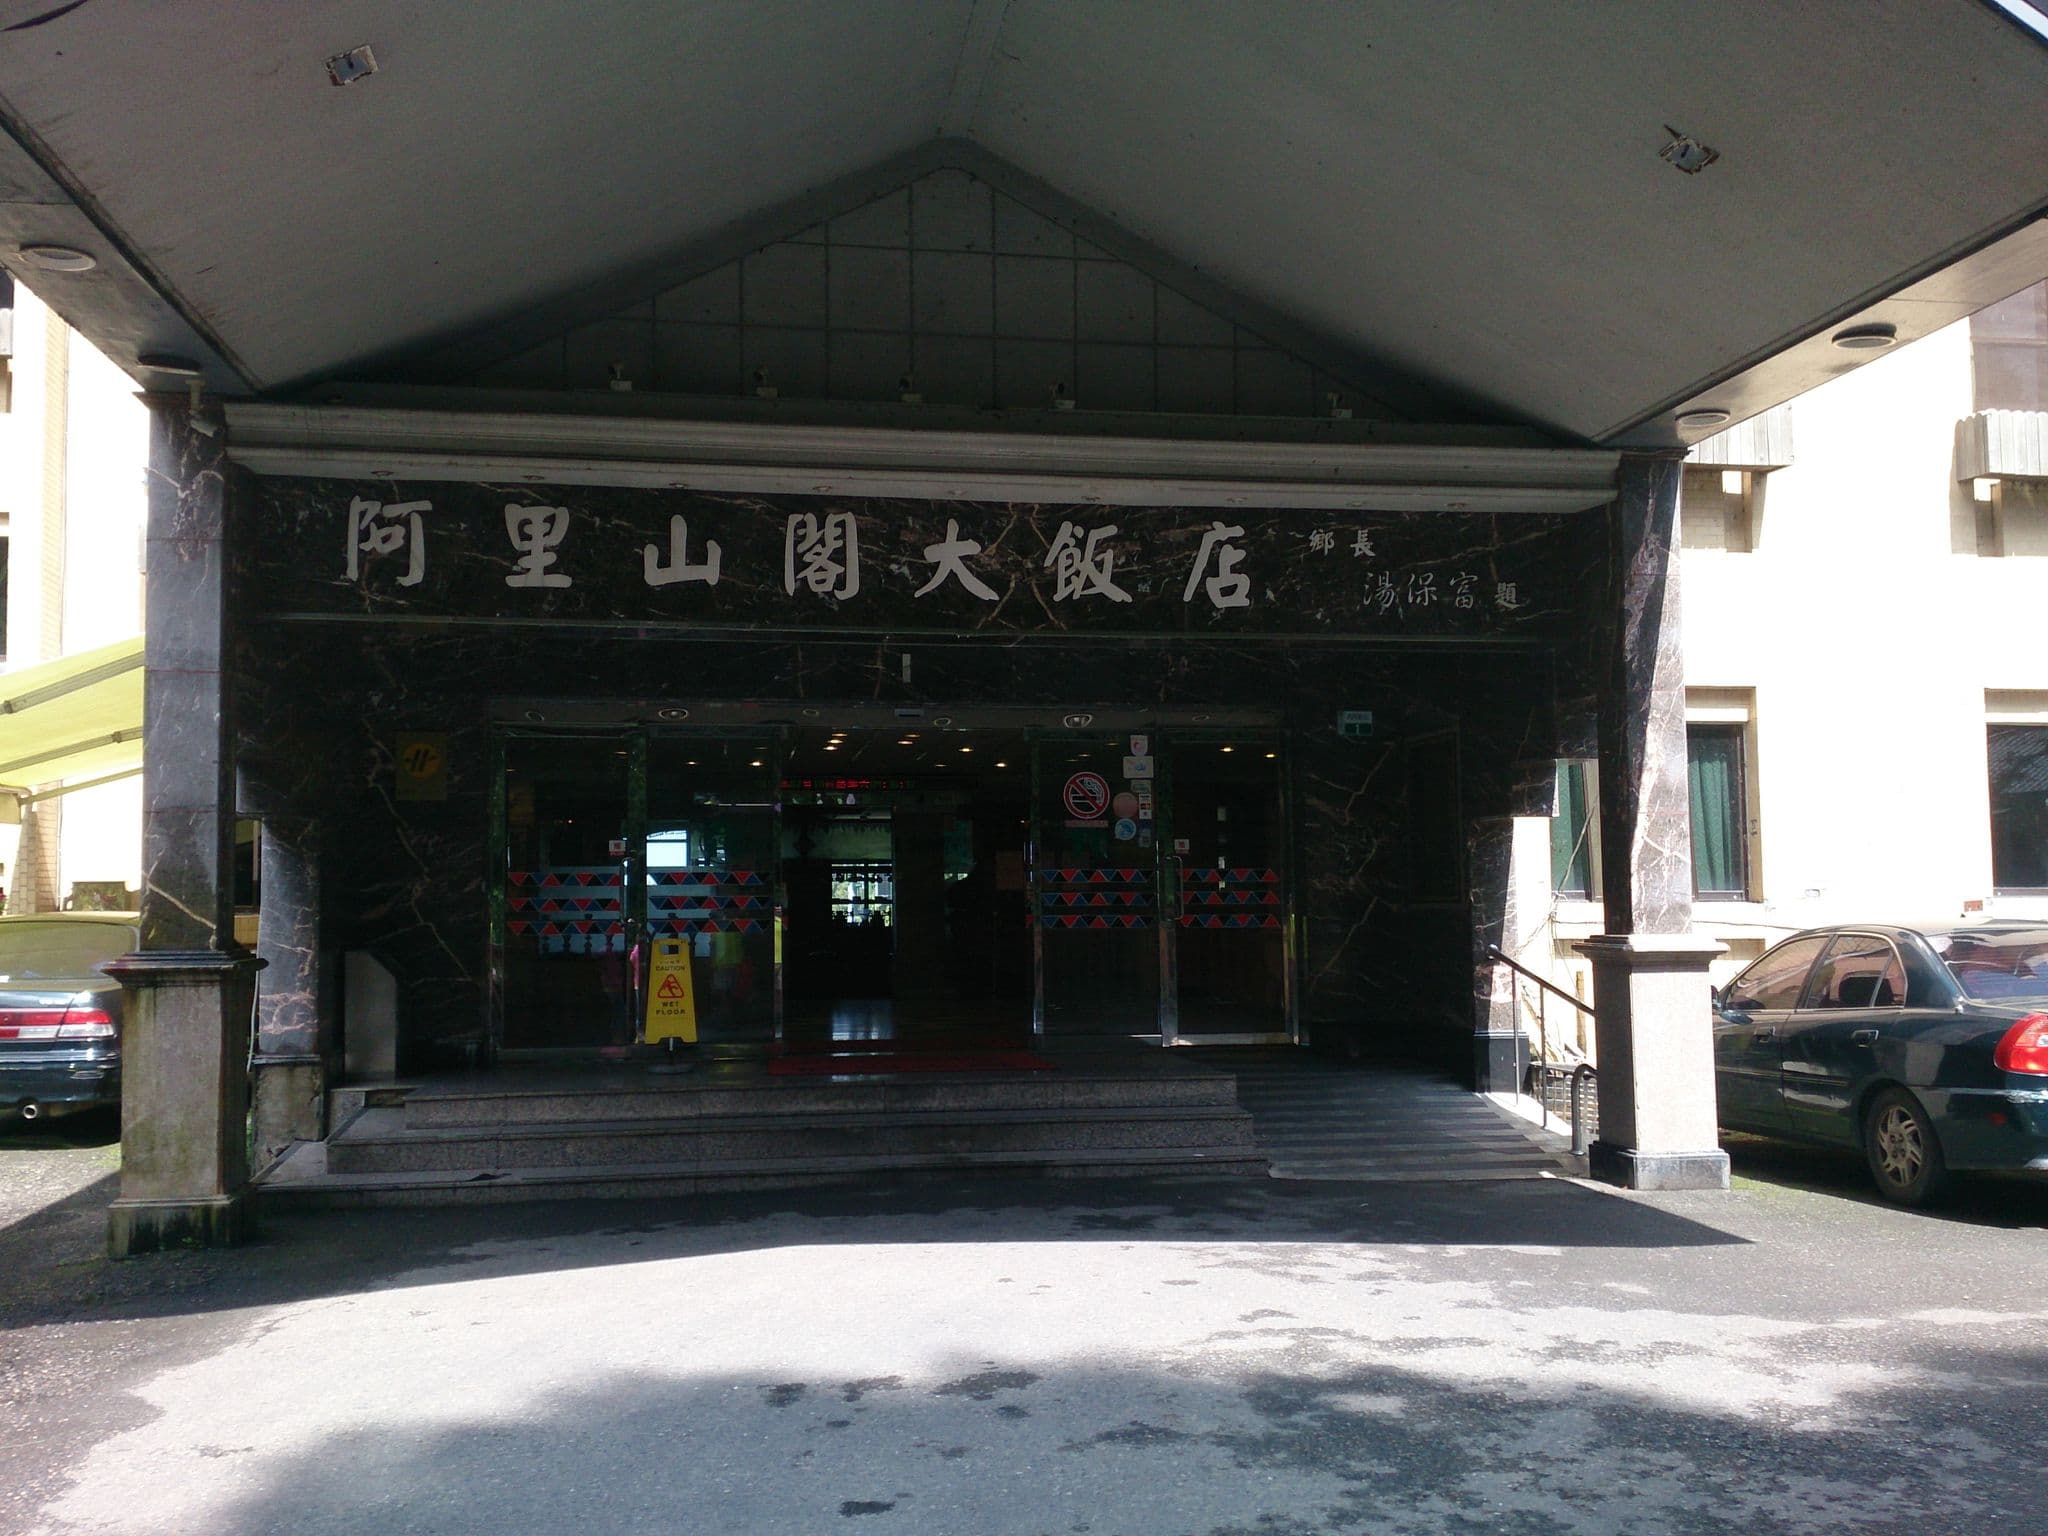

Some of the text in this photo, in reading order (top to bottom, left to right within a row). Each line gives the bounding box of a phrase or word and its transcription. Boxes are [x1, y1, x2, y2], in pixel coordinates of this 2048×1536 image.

[346, 495, 1251, 609] 阿里山閣大飯店
